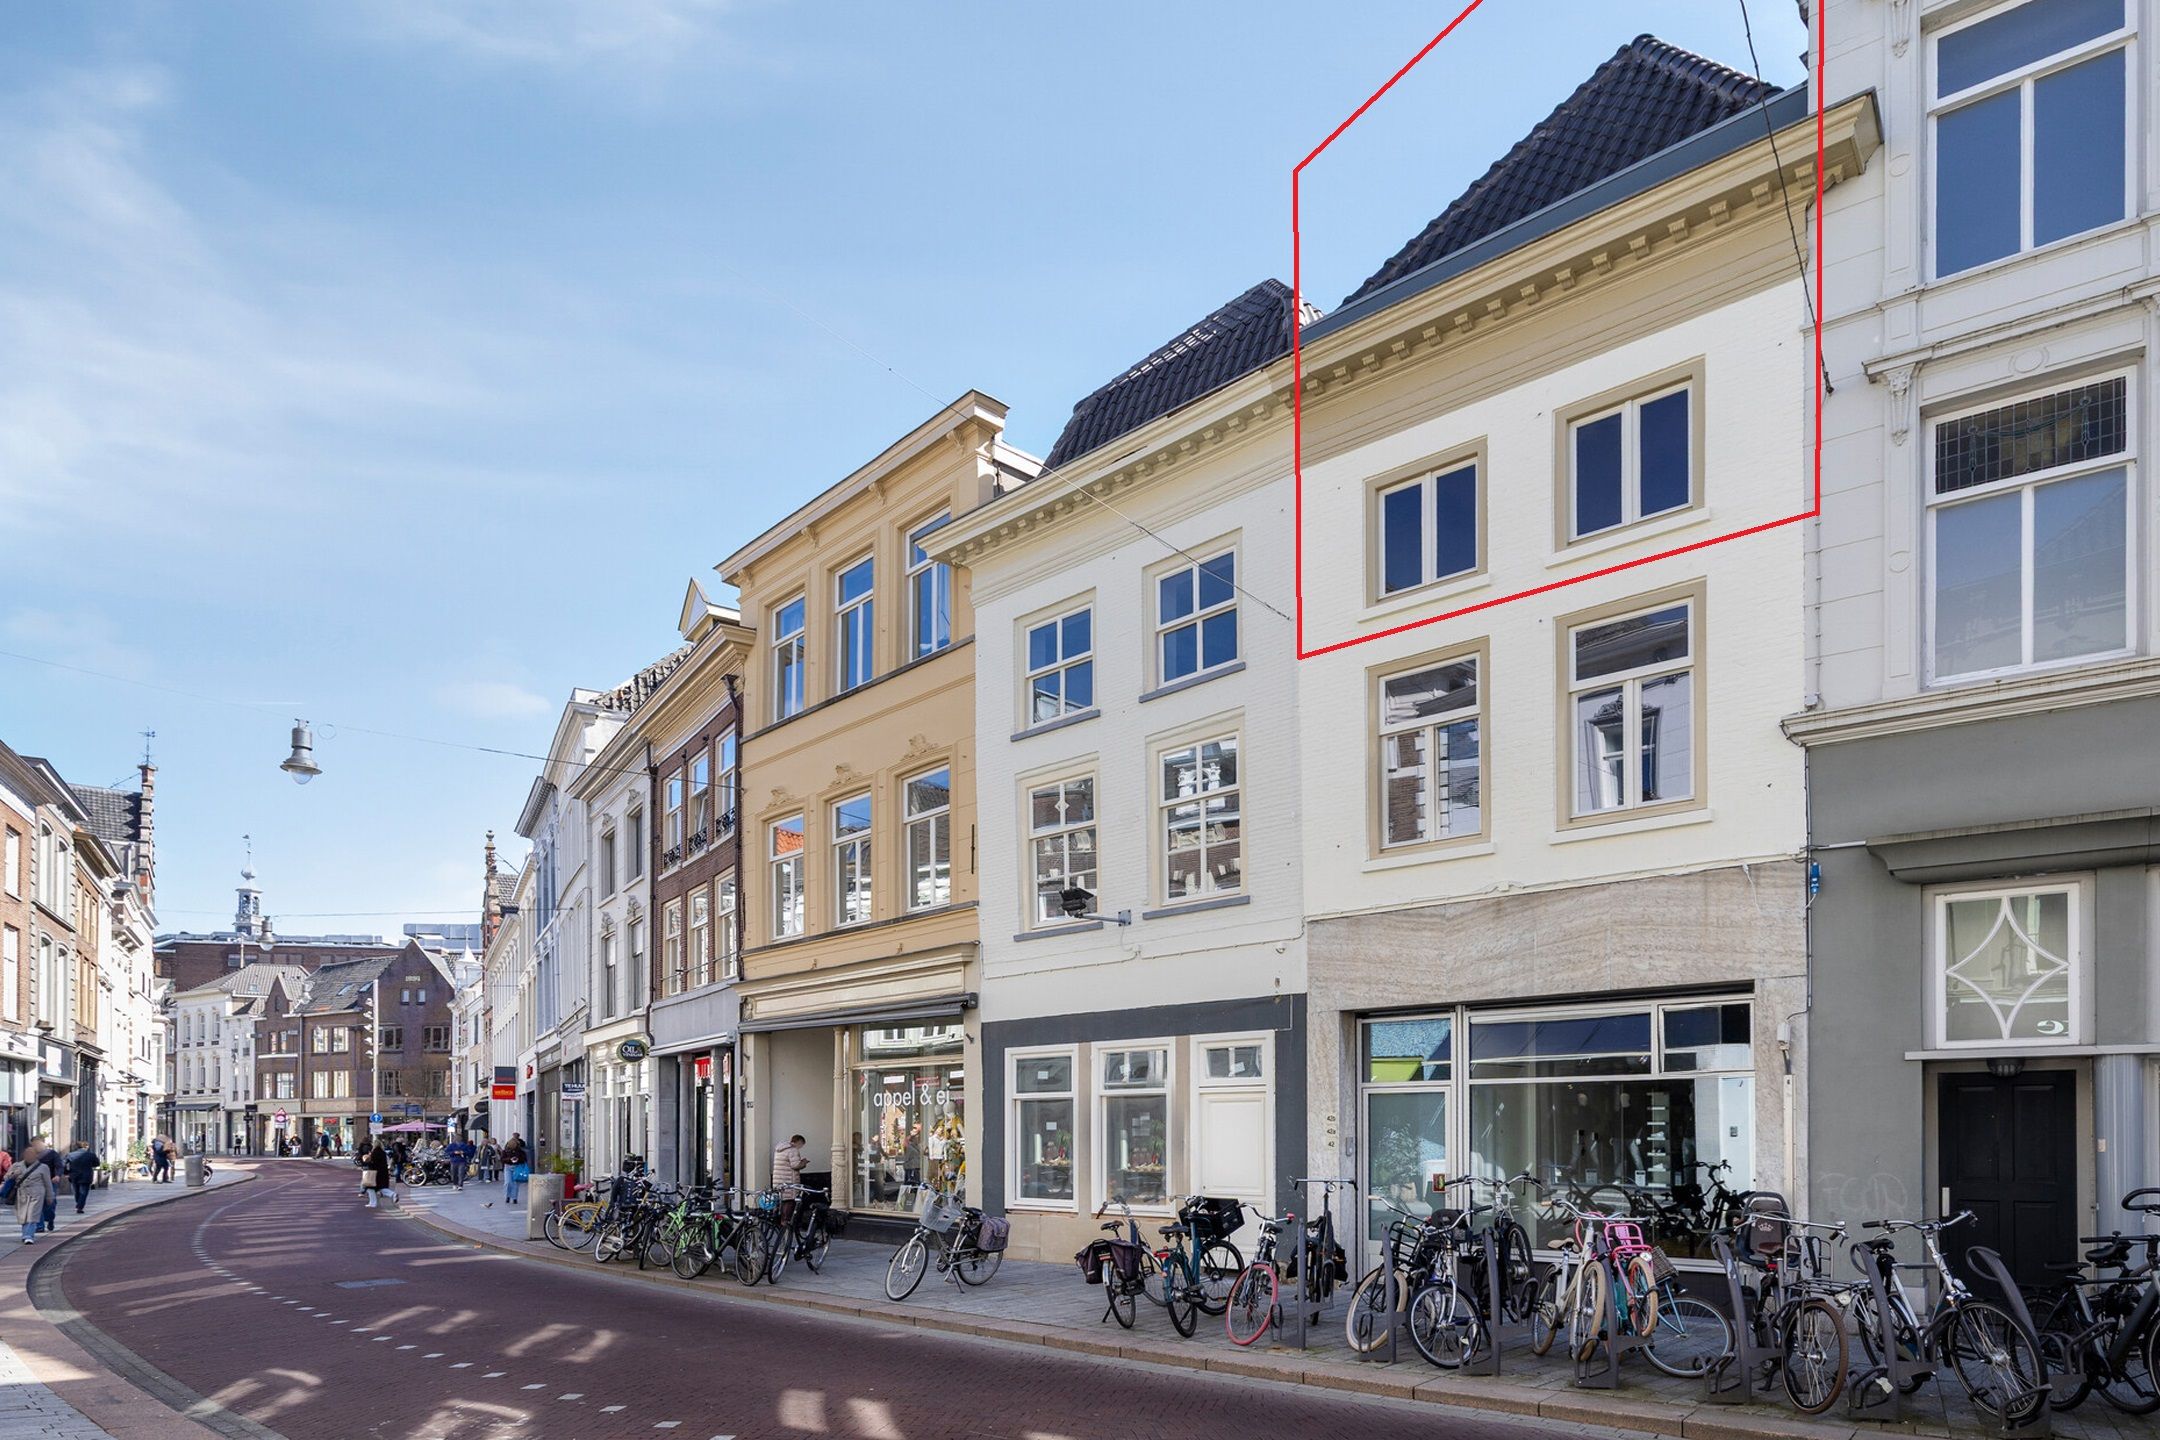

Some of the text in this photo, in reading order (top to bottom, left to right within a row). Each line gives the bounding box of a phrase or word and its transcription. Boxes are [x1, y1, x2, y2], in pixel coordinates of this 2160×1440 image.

[873, 1080, 950, 1112] appel & ei
